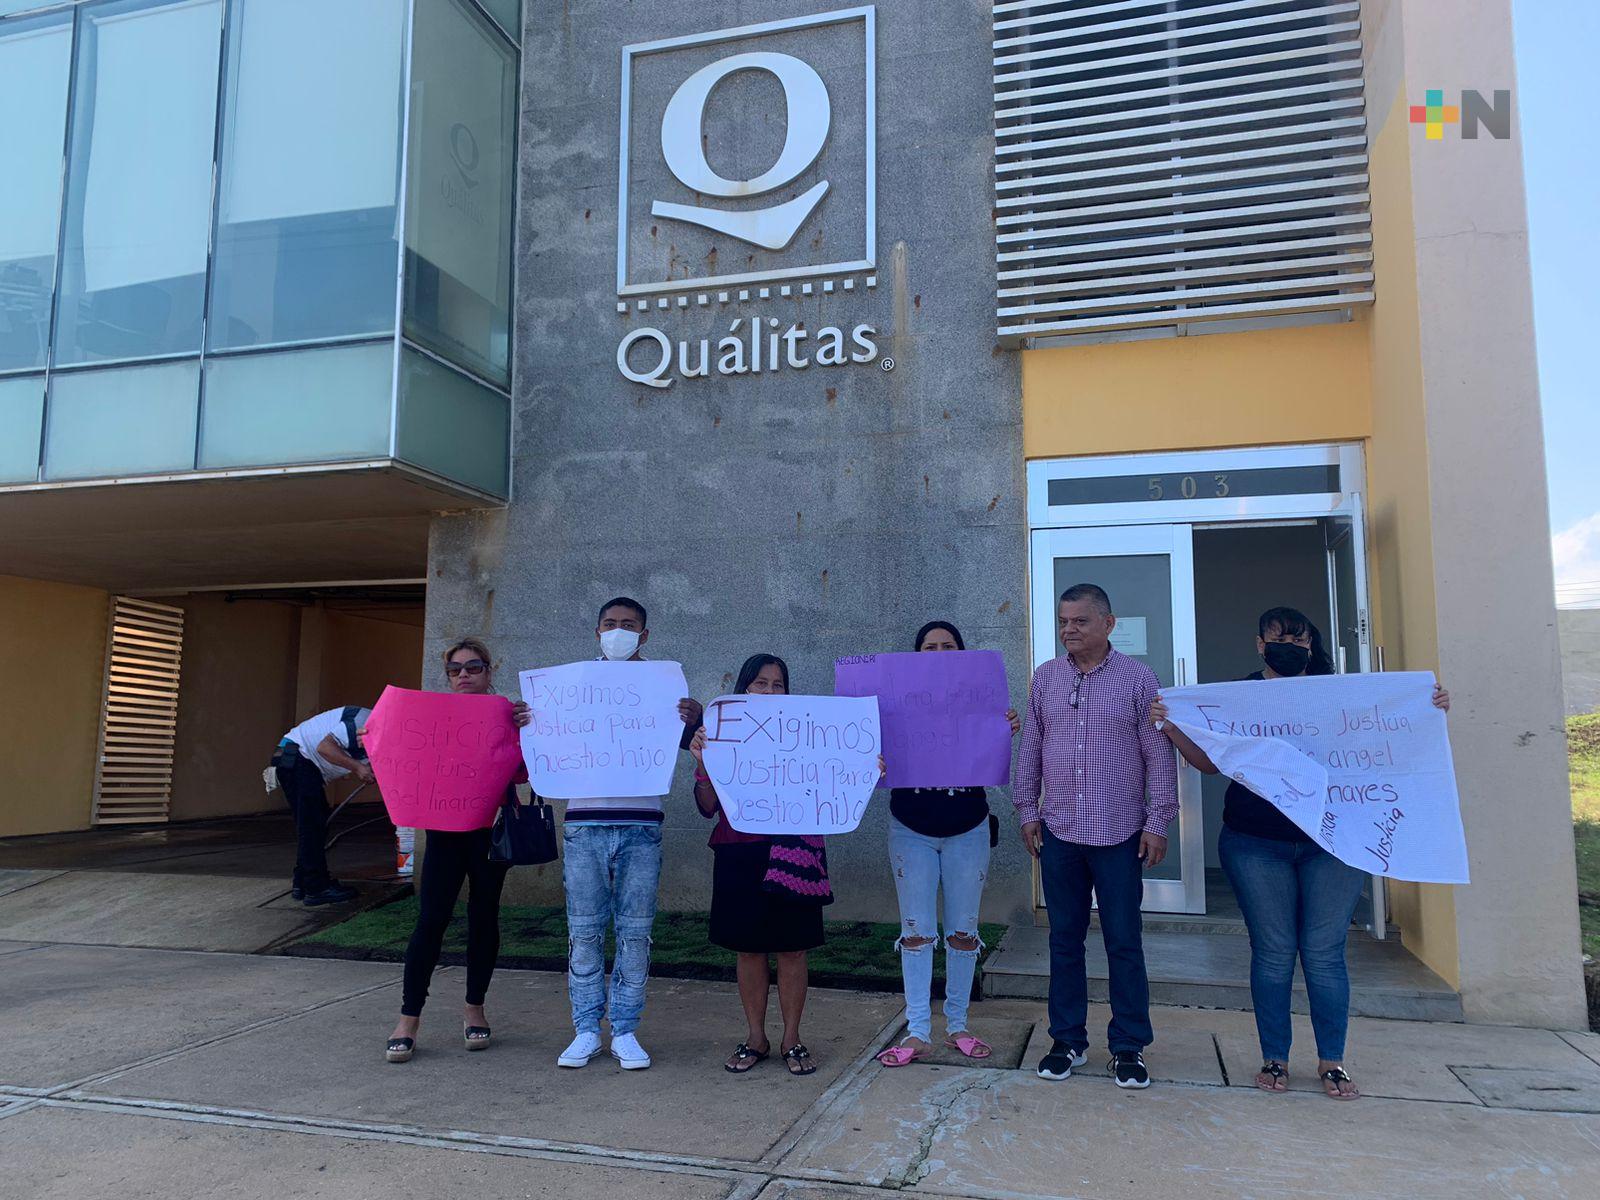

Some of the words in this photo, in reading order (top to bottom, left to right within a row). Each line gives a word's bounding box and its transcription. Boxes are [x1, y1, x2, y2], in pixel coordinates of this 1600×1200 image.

[616, 317, 879, 388] Quálitas
[1149, 474, 1230, 500] 503
[526, 673, 641, 711] Exigimos
[707, 700, 876, 753] Exigimos
[382, 757, 421, 777] ara
[716, 747, 819, 787] Justicia
[1328, 741, 1395, 771] angel
[732, 793, 804, 825] uestro
[1325, 783, 1399, 804] nares
